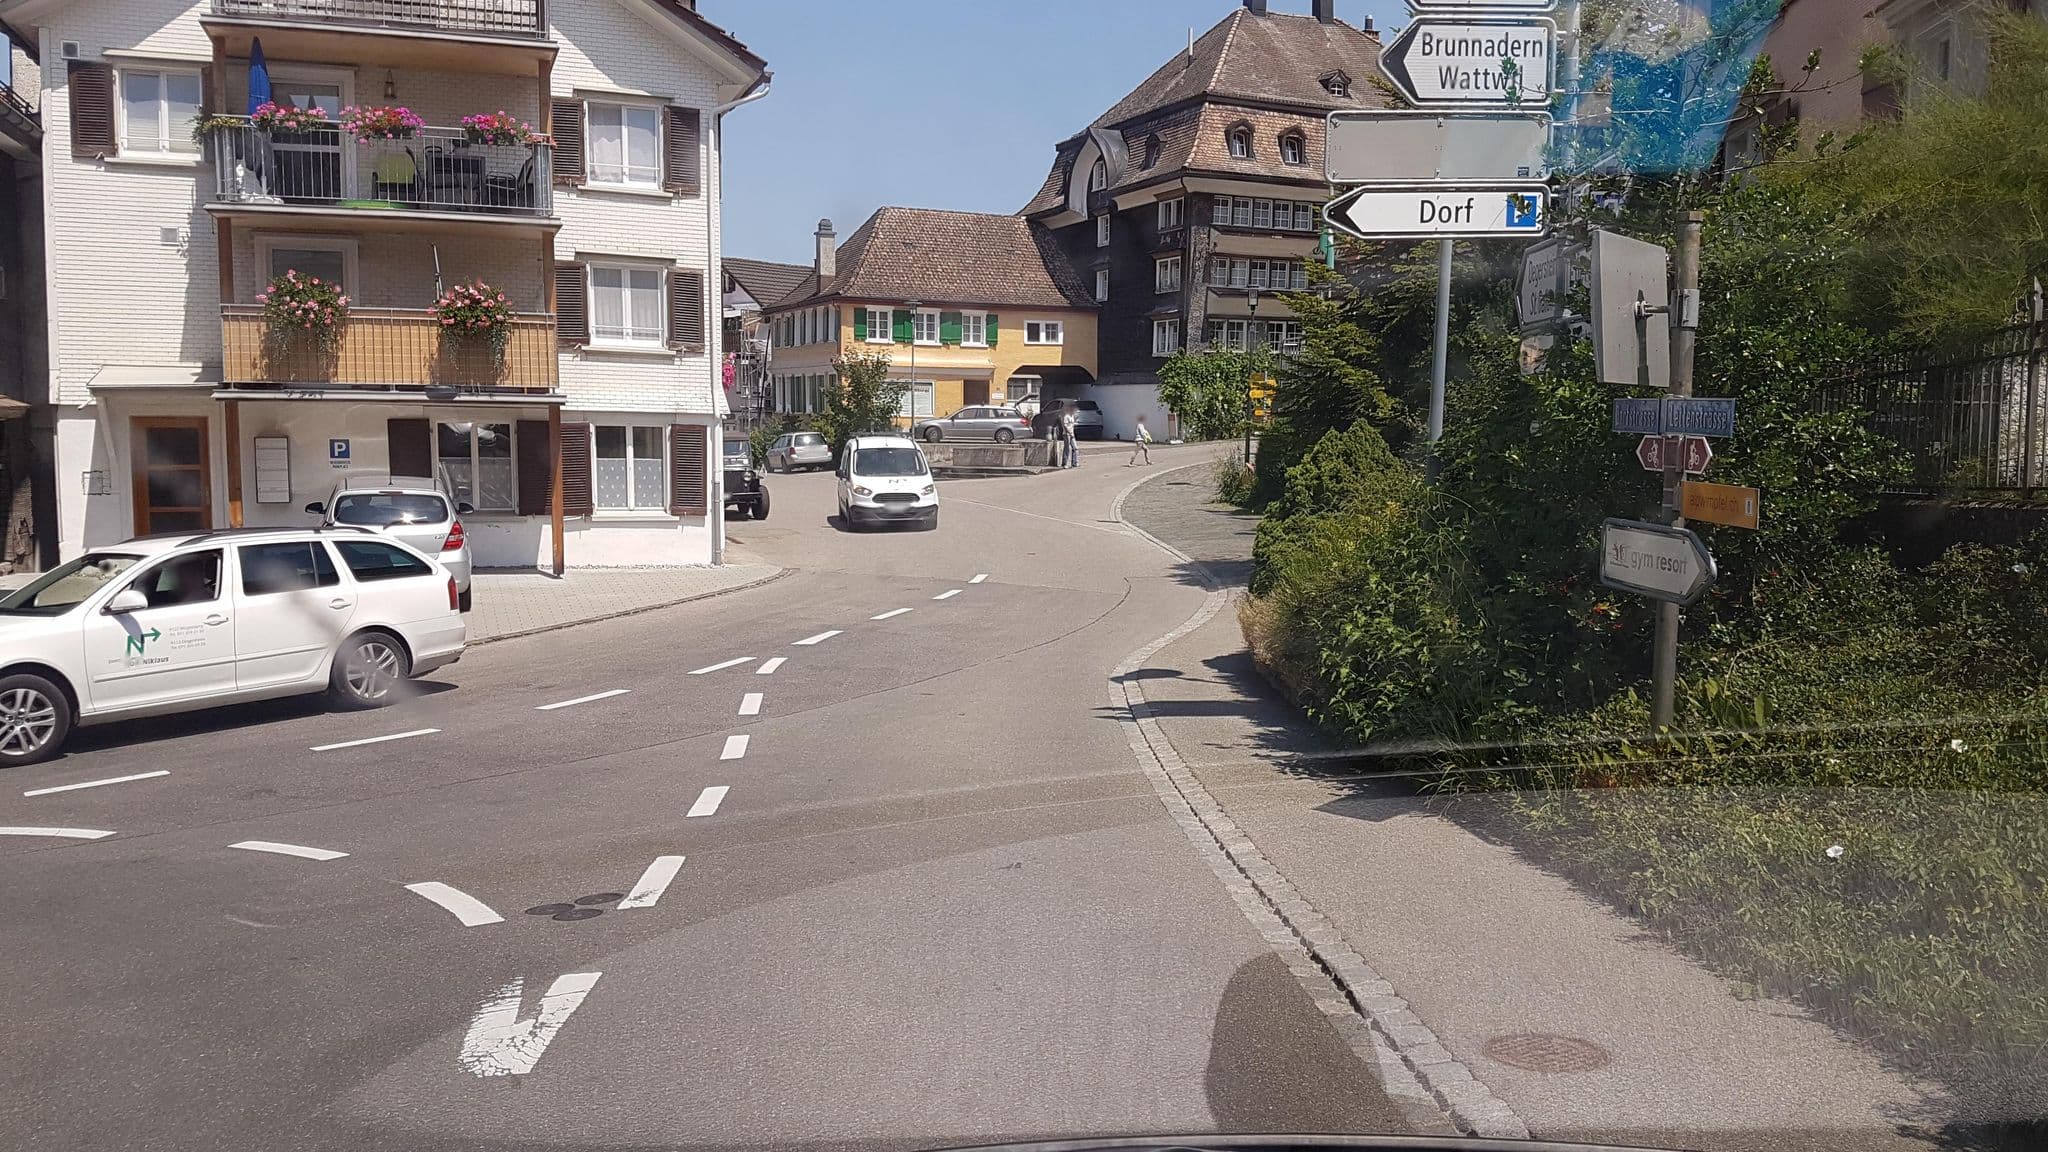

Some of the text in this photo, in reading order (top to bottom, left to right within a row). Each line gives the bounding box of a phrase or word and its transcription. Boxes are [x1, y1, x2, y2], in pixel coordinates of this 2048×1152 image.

[1422, 32, 1543, 57] Brunnadern
[1439, 65, 1523, 90] Wattwl
[1420, 197, 1474, 223] Dorf
[334, 441, 346, 457] P
[1631, 551, 1688, 575] gym resort
